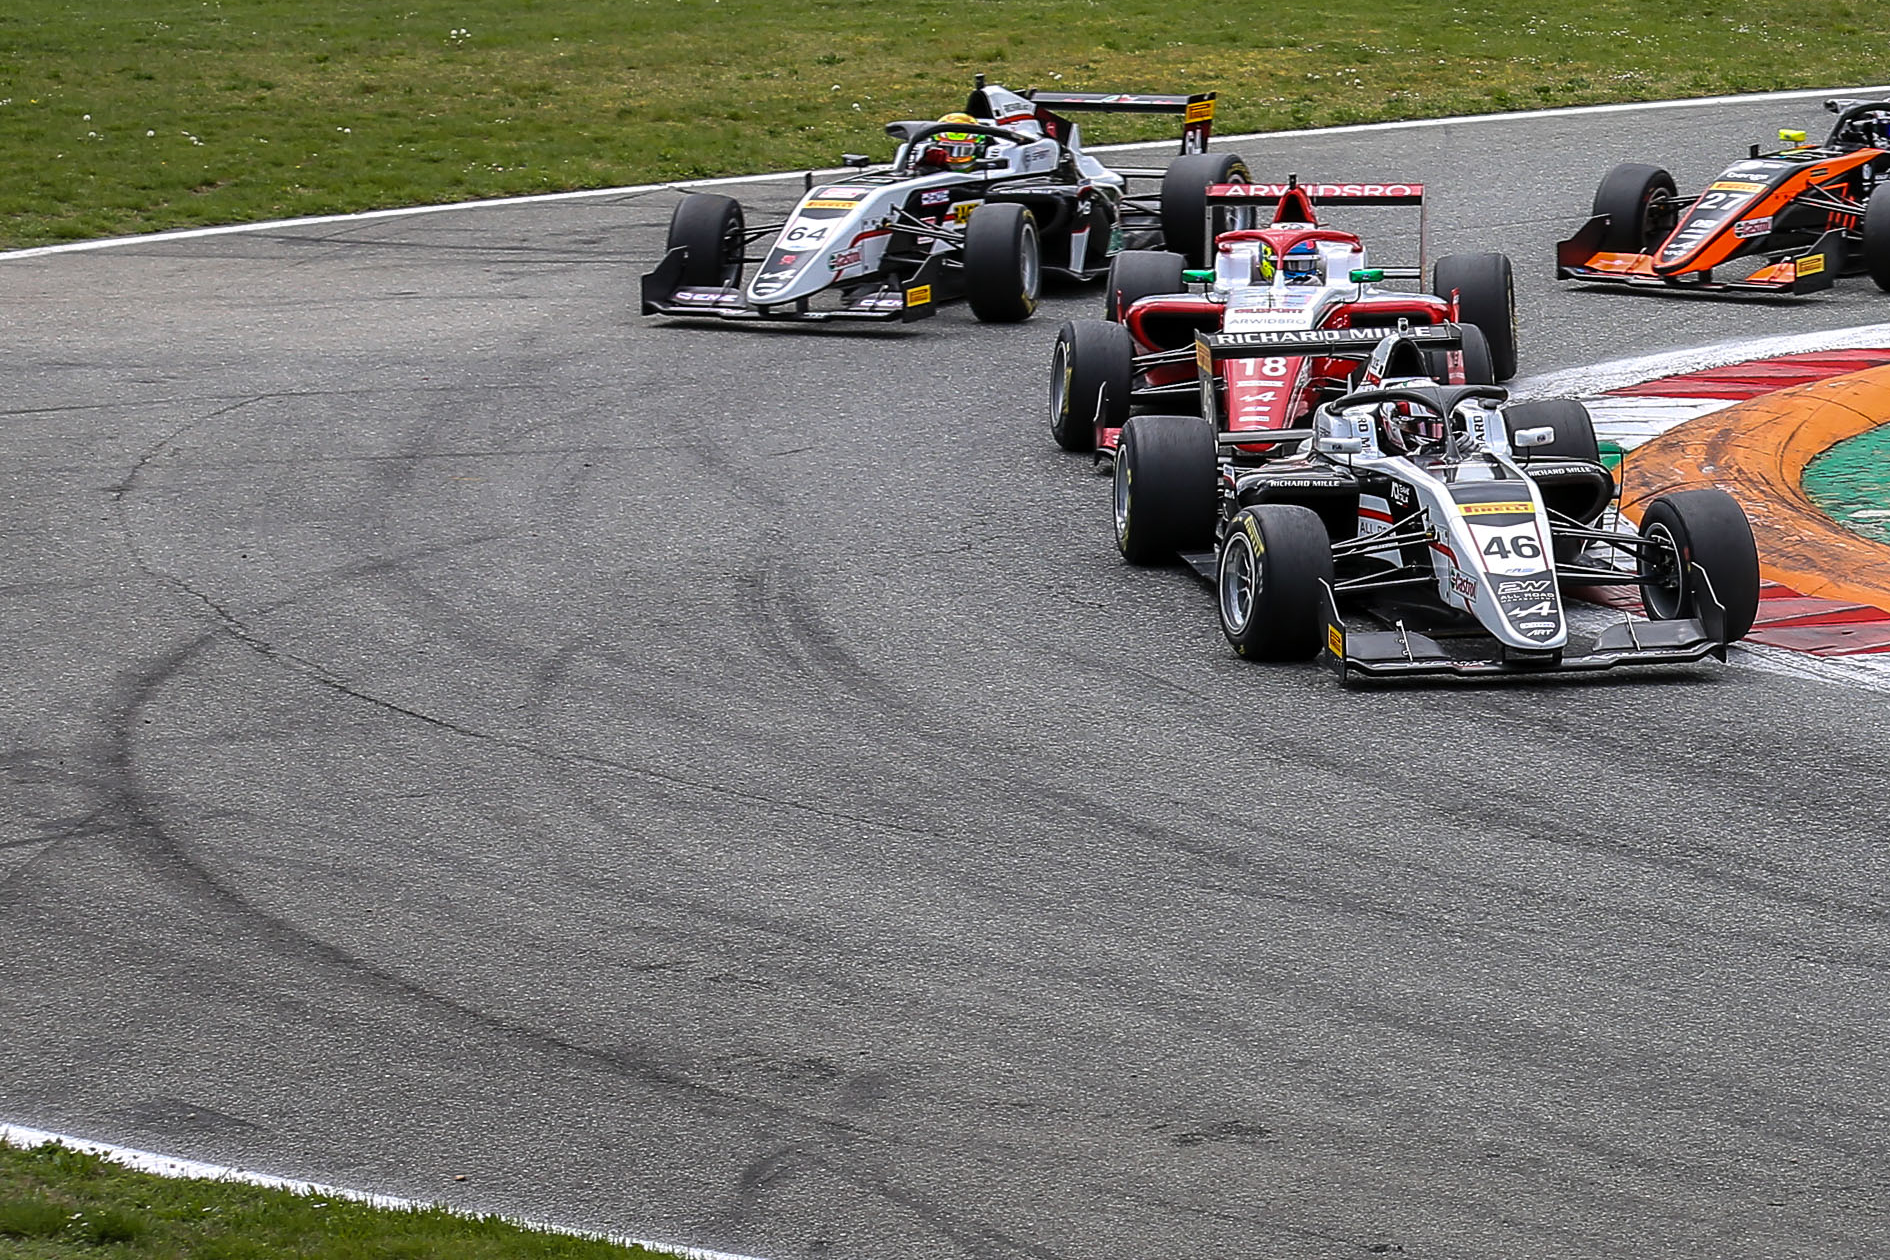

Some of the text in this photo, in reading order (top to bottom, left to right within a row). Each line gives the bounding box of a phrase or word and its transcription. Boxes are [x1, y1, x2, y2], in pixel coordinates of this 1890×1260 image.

[1696, 192, 1750, 211] 27
[786, 227, 829, 242] 64
[1217, 328, 1341, 345] RICHARD
[1239, 356, 1288, 377] 18
[1528, 465, 1593, 477] RICHARD MILLE
[1270, 479, 1341, 488] RICHARD MILLE
[1483, 535, 1541, 559] 46
[1454, 573, 1477, 599] Castrol
